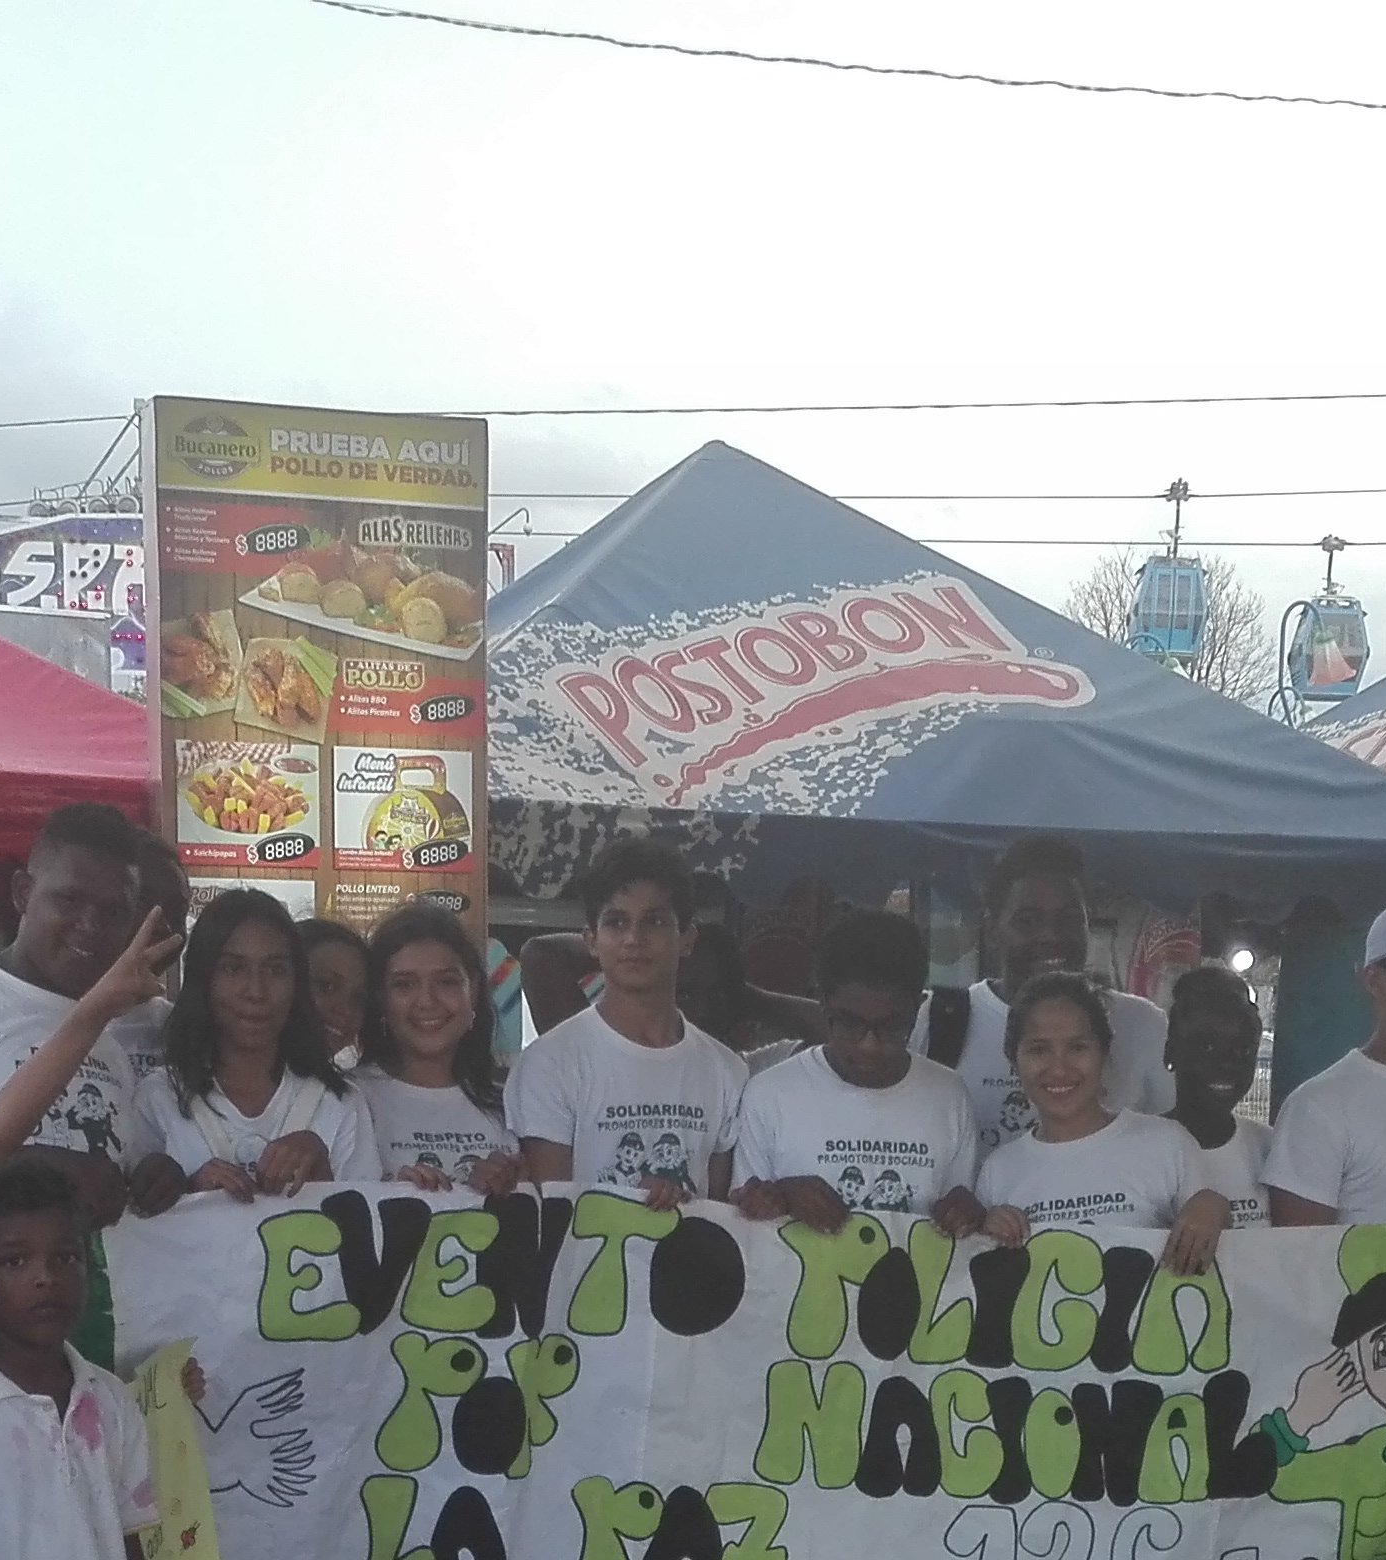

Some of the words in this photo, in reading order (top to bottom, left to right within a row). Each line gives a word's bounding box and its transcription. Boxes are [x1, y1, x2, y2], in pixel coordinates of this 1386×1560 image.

[174, 435, 257, 458] Bucanero
[269, 428, 391, 460] PRUEBA
[396, 438, 470, 465] AQUÍ
[269, 456, 344, 480] POLLO
[349, 462, 378, 482] DE
[383, 464, 478, 489] VERDAD.
[255, 529, 298, 552] 8888
[361, 518, 402, 543] ALAS
[405, 525, 472, 548] RELLENAS
[357, 662, 394, 671] ALITAS
[397, 663, 411, 671] DE
[556, 586, 1012, 768] POSTOBON
[347, 669, 421, 687] POLLO
[427, 699, 466, 721] 8888
[356, 754, 396, 772] Menú
[338, 774, 394, 792] Infantil
[265, 839, 304, 860] 8888
[420, 844, 458, 865] 8888
[335, 884, 364, 893] POLLO
[366, 885, 400, 894] ENTERO
[605, 1104, 704, 1120] SOLIDARIDAD
[413, 1132, 486, 1143] RESPETO
[825, 1140, 929, 1156] SOLIDARIDAD
[817, 1154, 887, 1167] PROMOTORES
[258, 1190, 747, 1341] EVENTO
[754, 1360, 1277, 1506] NACIONAL
